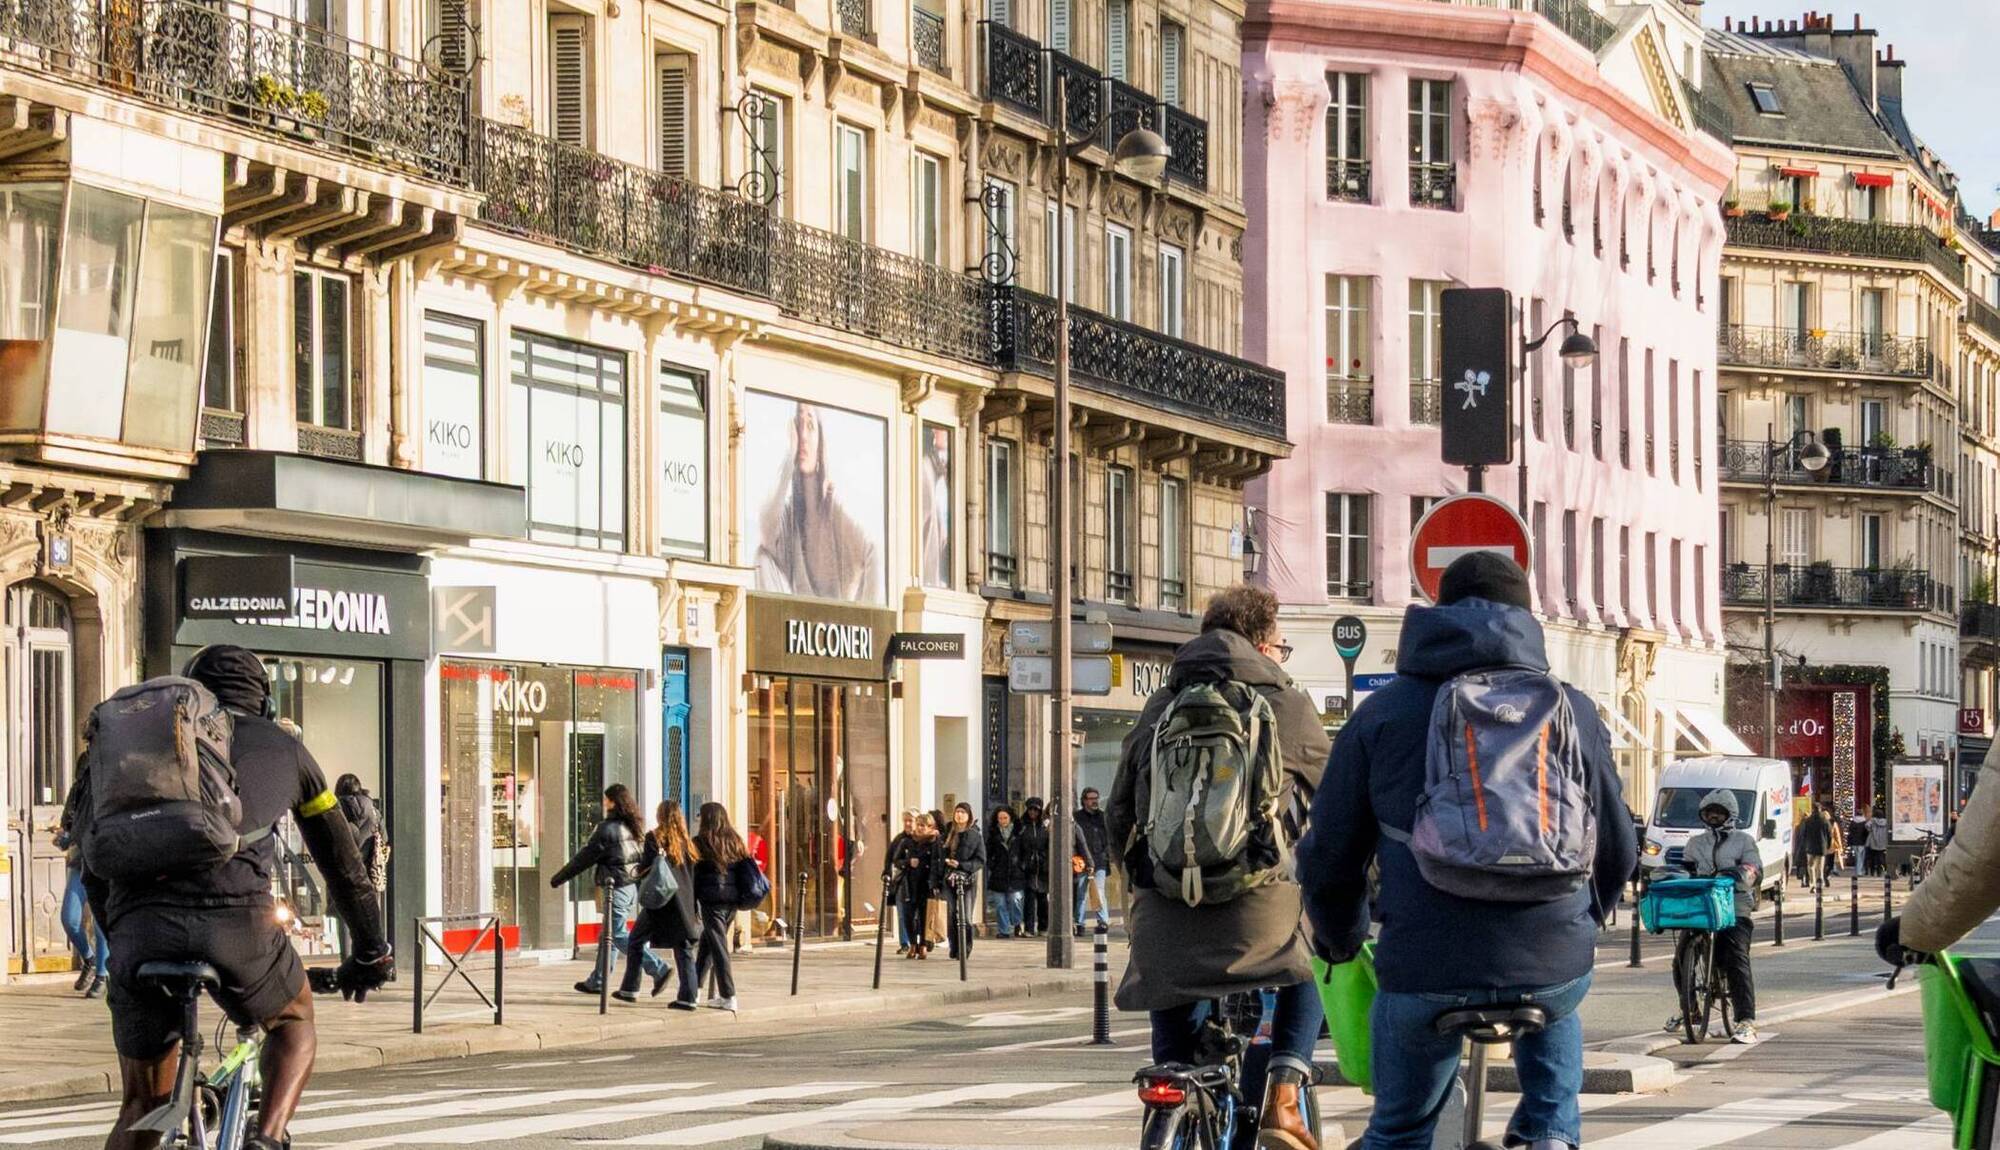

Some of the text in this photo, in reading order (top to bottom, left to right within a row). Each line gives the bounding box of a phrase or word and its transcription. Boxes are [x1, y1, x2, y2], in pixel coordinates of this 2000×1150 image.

[429, 418, 471, 449] KIKO
[545, 440, 584, 468] KIKO
[664, 460, 698, 486] KIKO
[190, 597, 286, 611] CALZEDONIA
[787, 619, 873, 660] FALCONERI
[1336, 625, 1361, 639] BUS
[900, 640, 959, 652] FALCONERI
[493, 680, 547, 714] KIKO
[1789, 718, 1825, 737] d'Or
